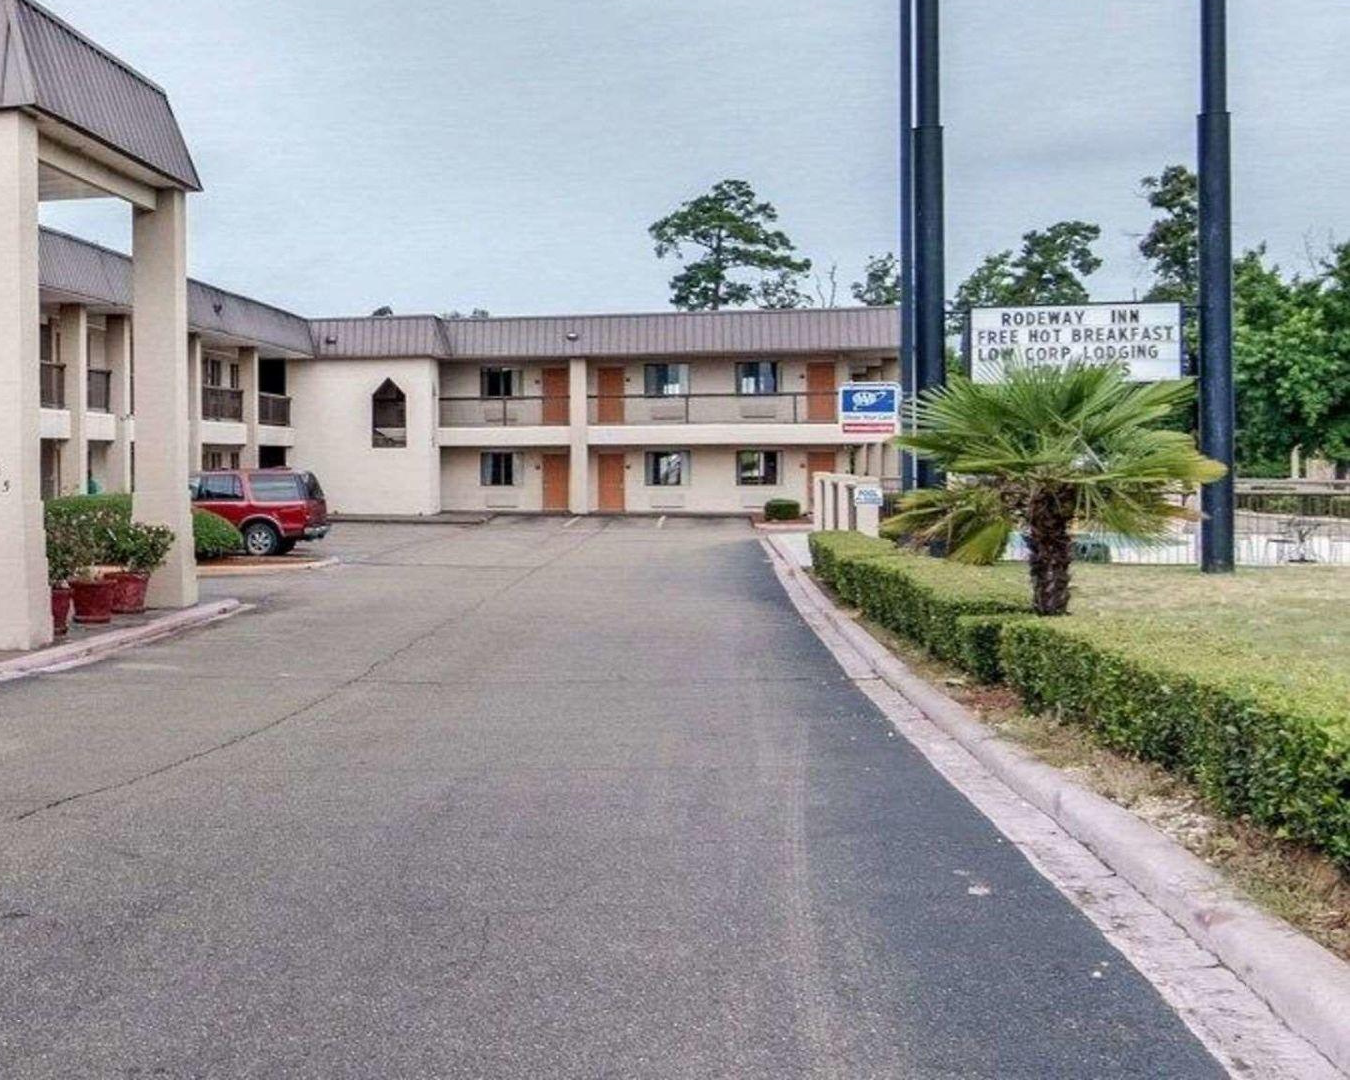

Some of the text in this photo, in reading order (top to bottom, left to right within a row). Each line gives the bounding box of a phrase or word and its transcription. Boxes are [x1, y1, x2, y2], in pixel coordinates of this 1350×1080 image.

[1001, 308, 1140, 327] RODEWAY INN
[977, 325, 1174, 345] FREE HOT BREAKFAST
[1025, 347, 1071, 361] CORP
[1083, 344, 1159, 360] LODGING
